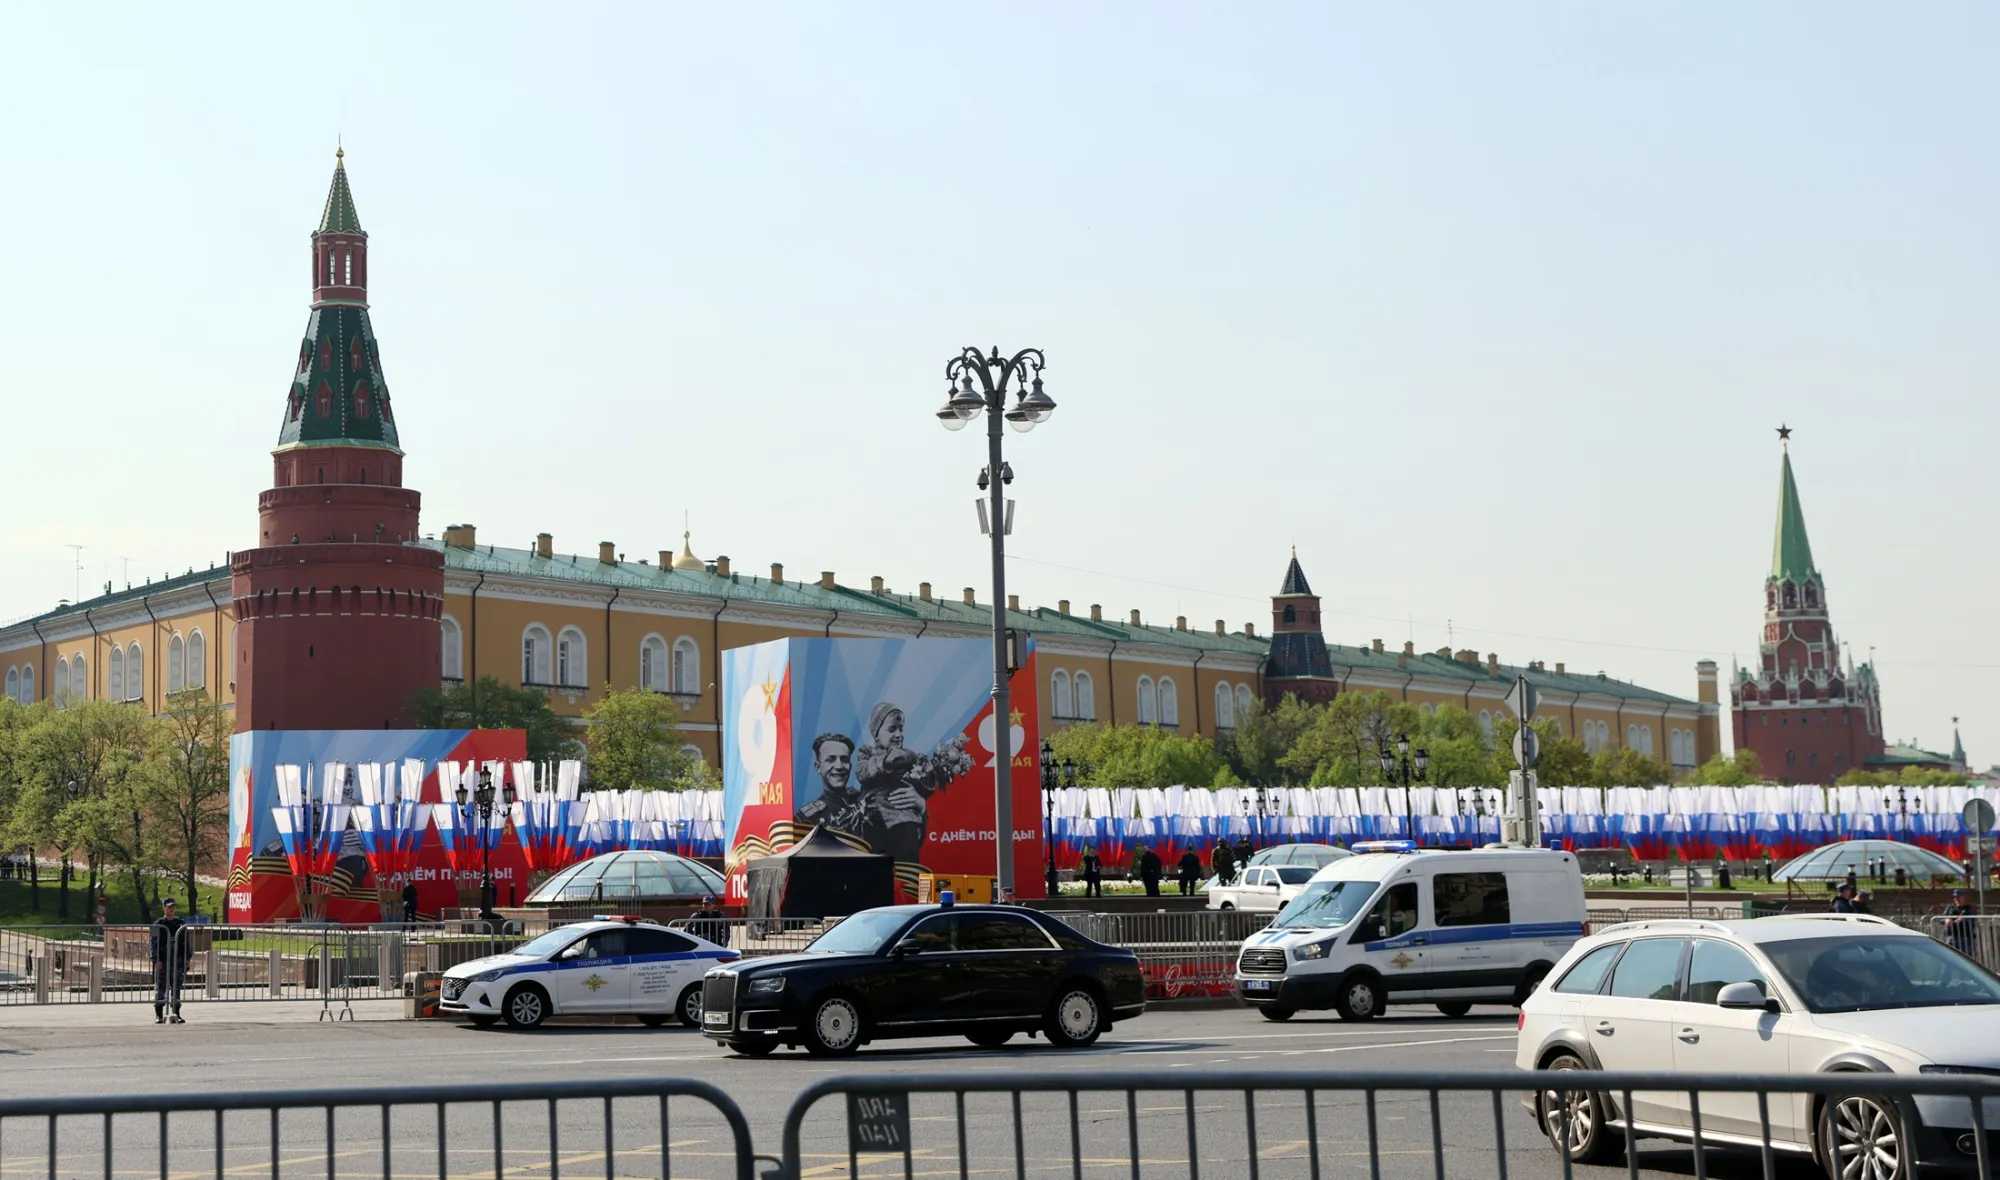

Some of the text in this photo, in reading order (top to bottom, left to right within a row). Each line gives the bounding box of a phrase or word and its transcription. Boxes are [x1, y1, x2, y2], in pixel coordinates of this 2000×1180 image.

[738, 683, 783, 806] 9 МАЯ
[929, 829, 1035, 843] С ДНЁМ ПОДЫ!
[229, 892, 251, 912] ПОБЕДА!
[577, 958, 613, 967] ПОЛИЦИЯ
